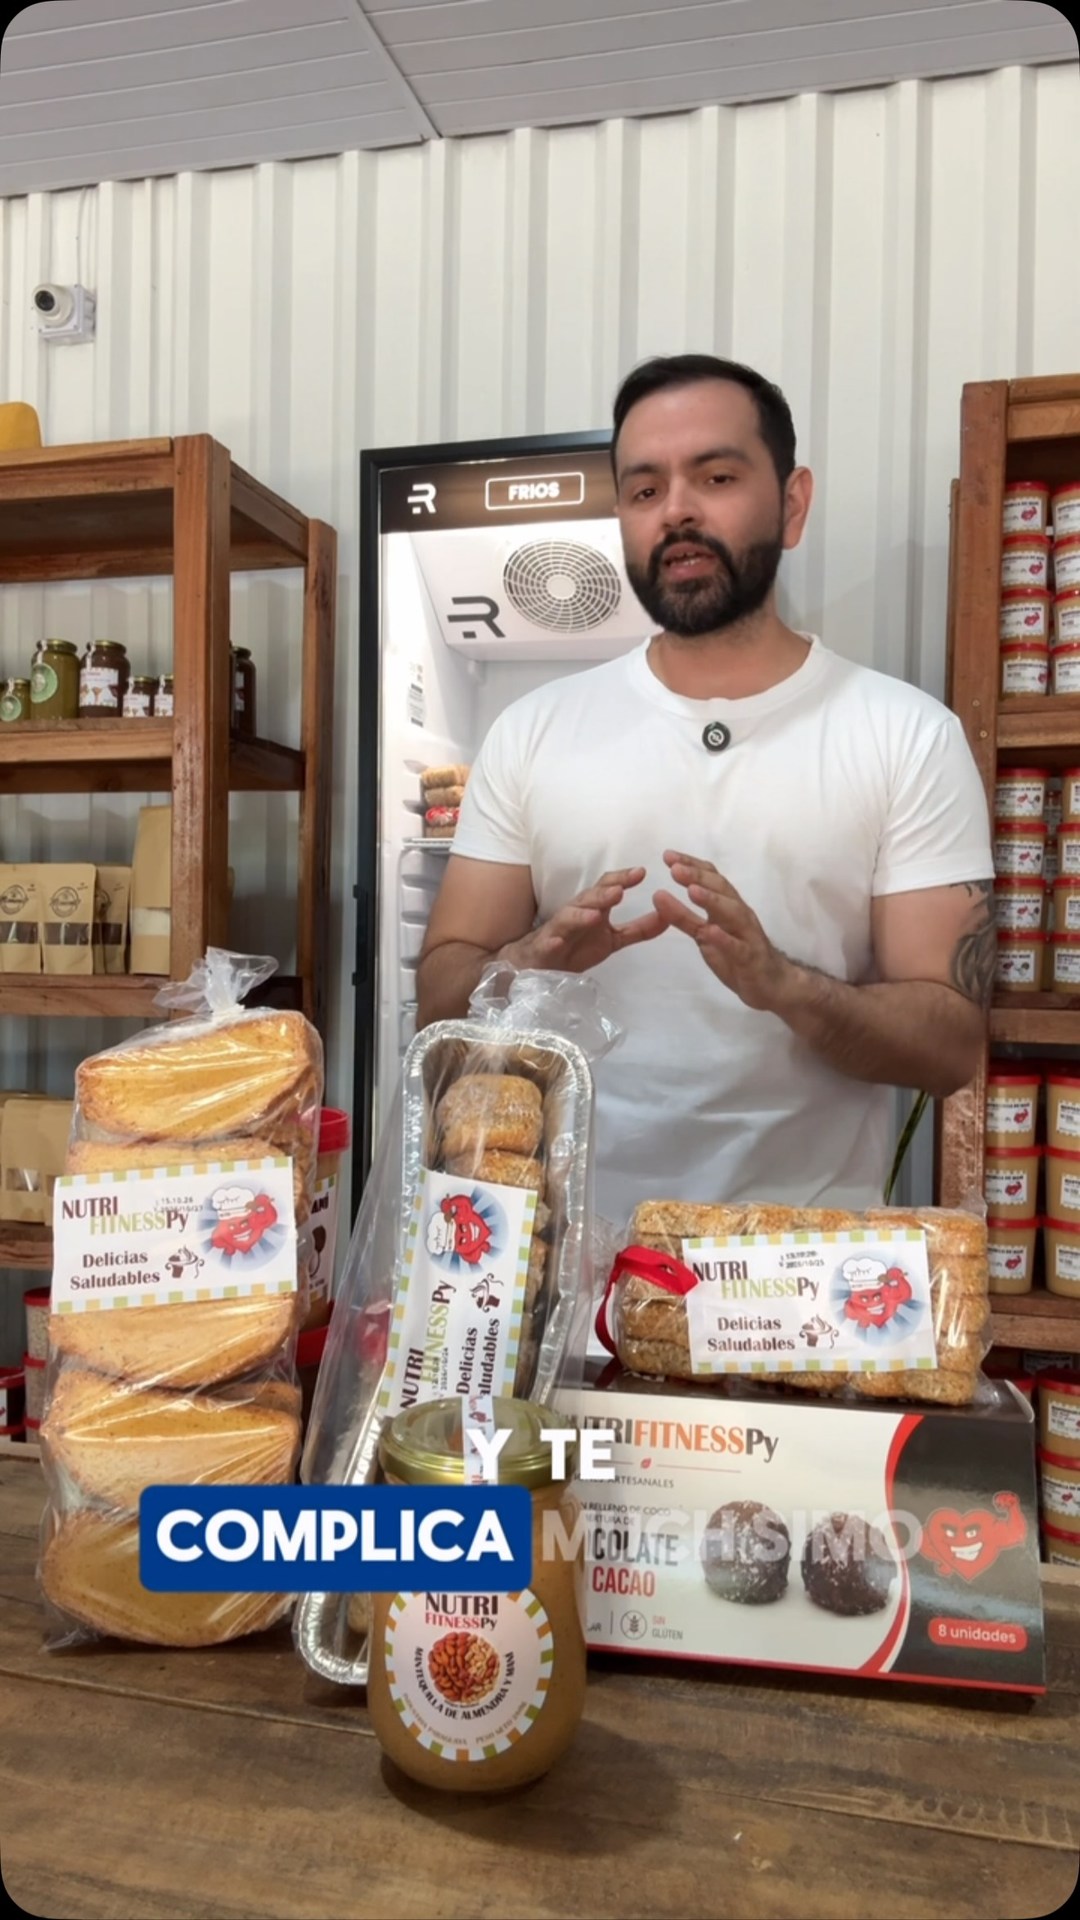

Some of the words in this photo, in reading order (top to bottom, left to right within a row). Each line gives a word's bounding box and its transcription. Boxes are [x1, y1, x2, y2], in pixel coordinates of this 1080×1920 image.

[508, 482, 560, 501] FRIOS
[62, 1196, 119, 1219] NUTRI
[90, 1210, 188, 1236] FITNESSPy
[82, 1250, 148, 1269] Delicias
[70, 1271, 161, 1290] Saludables
[693, 1260, 748, 1281] NUTRI
[721, 1276, 819, 1301] FITNESSPy
[717, 1316, 782, 1331] Delicias
[707, 1336, 796, 1352] Saludables
[456, 1327, 477, 1394] Delicias
[478, 1318, 500, 1397] aludables
[400, 1347, 424, 1409] NUTRI
[642, 1506, 672, 1516] COCO
[592, 1566, 656, 1597] CACAO
[425, 1592, 499, 1616] NUTRI
[425, 1612, 498, 1631] FITNESSPy
[938, 1624, 947, 1637] 8
[950, 1626, 1017, 1643] unidades
[444, 1707, 458, 1720] DE
